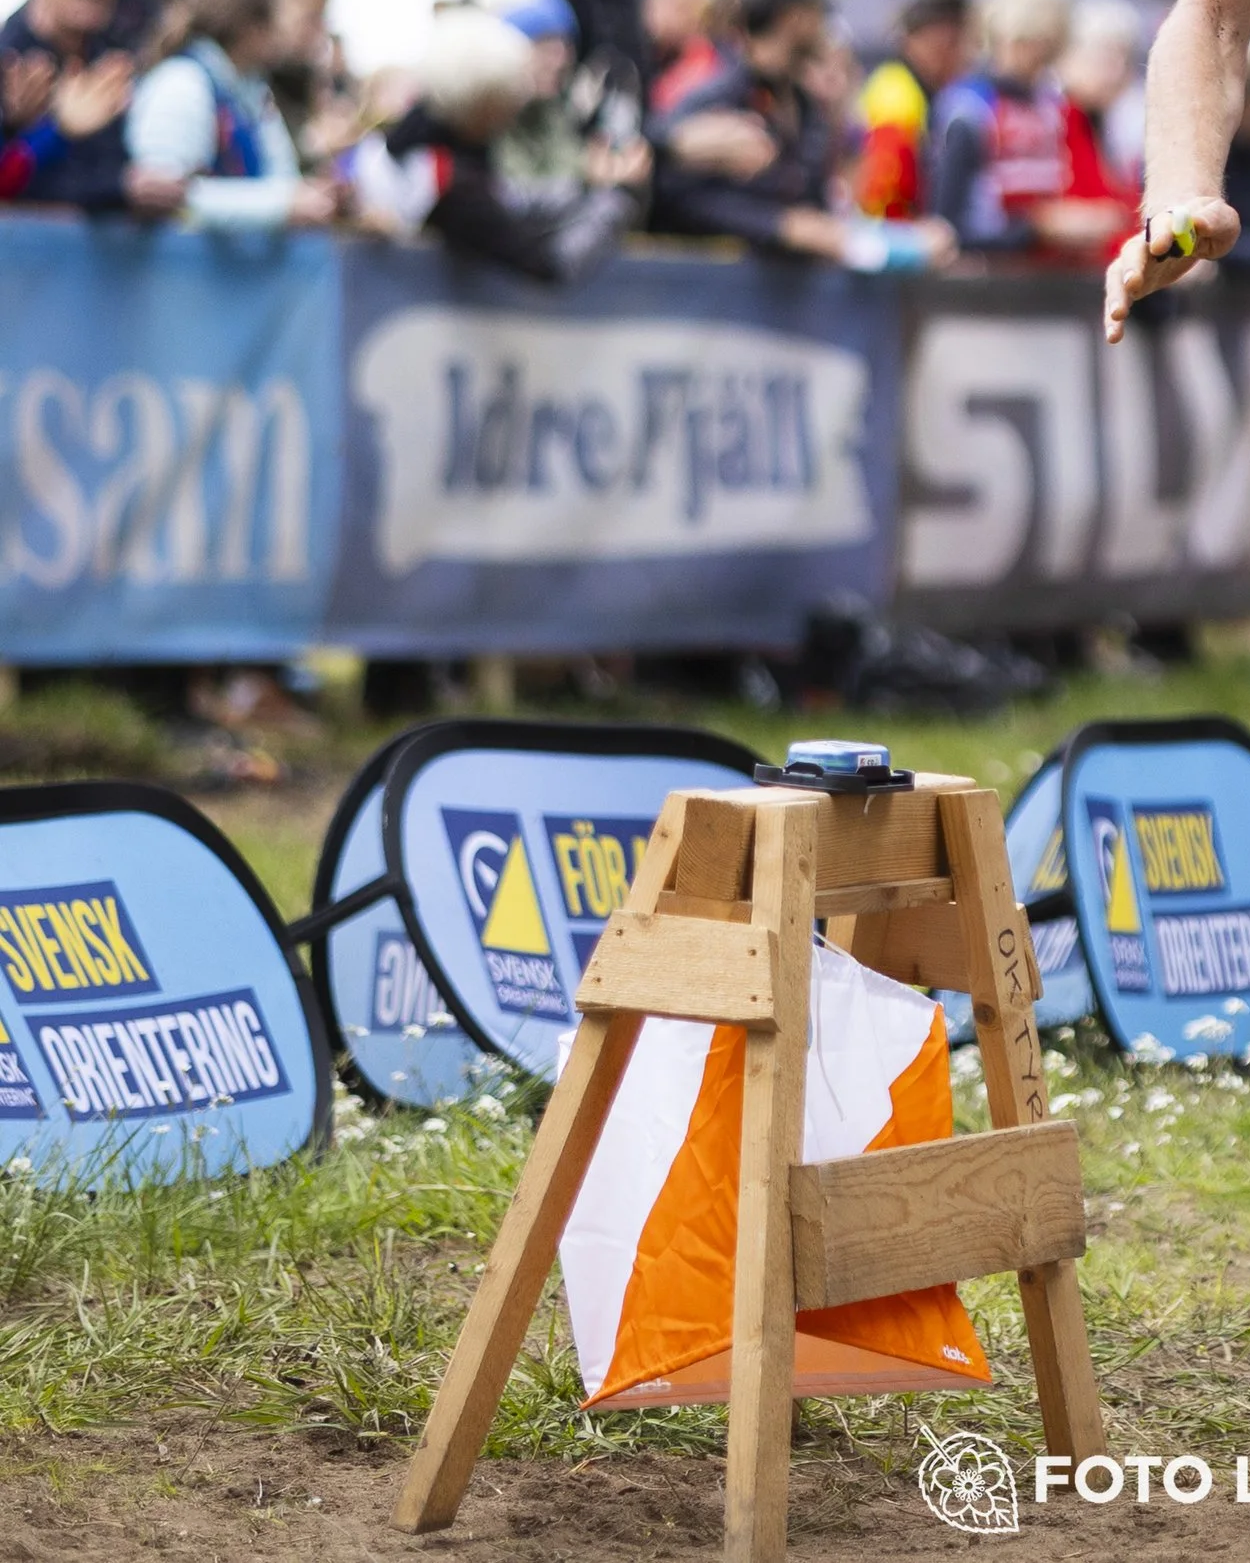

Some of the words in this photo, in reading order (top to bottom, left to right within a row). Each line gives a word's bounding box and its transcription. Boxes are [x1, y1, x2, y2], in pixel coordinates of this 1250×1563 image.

[1134, 811, 1225, 891] SVENSK
[0, 896, 150, 992] SVENSK
[39, 1000, 280, 1114] ORIENTERING
